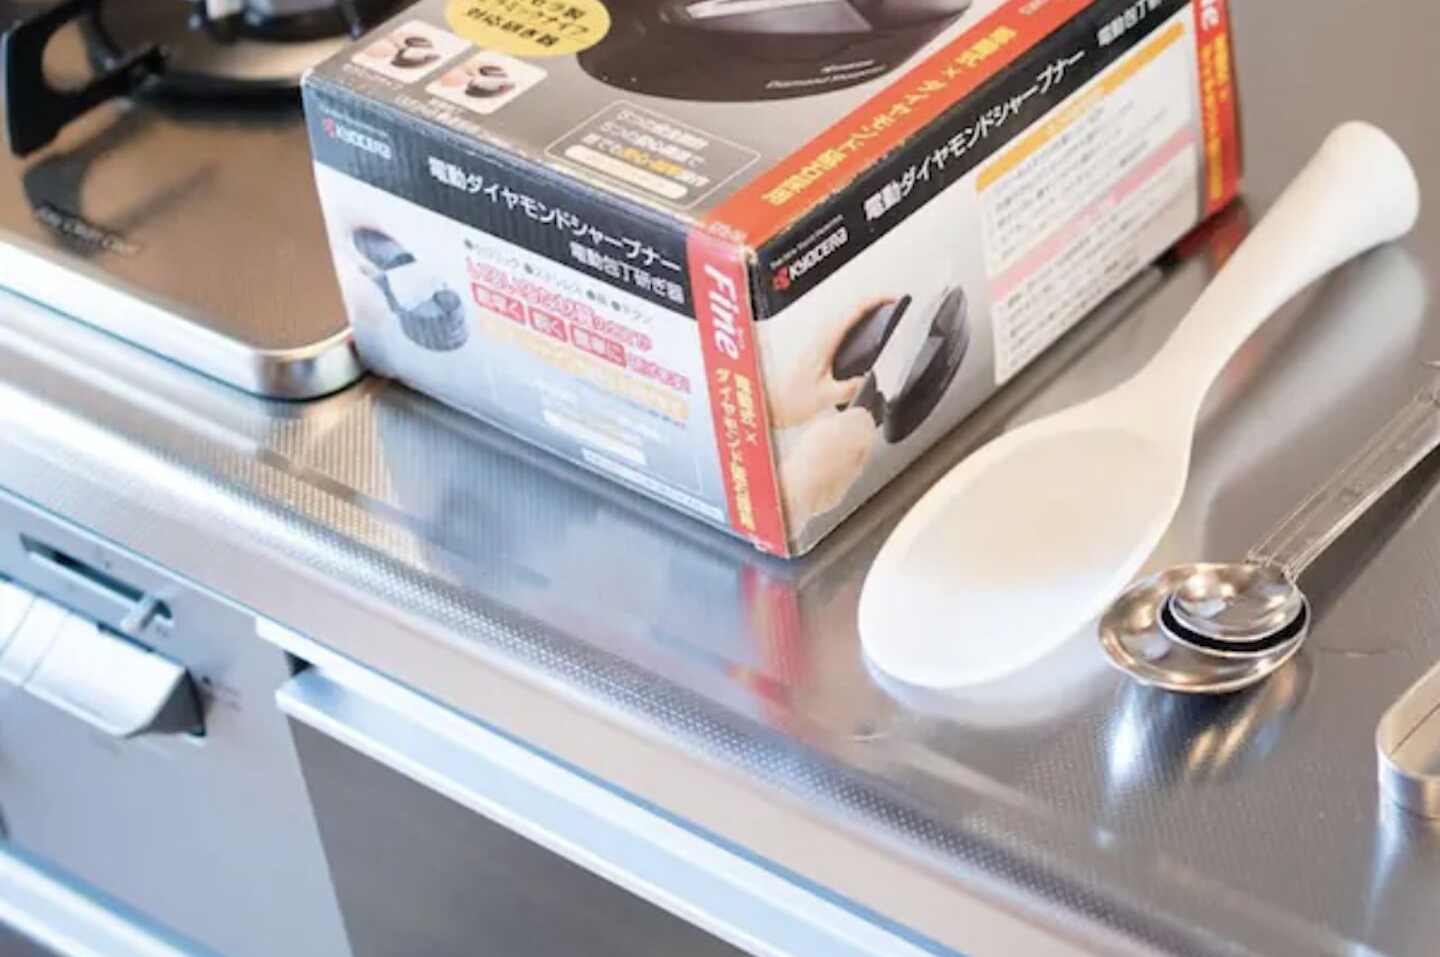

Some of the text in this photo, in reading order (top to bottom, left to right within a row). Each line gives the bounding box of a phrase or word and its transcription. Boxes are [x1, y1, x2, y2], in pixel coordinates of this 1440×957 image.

[862, 47, 1086, 222] 電動ダイヤモンドシャープナー
[427, 155, 682, 272] 電動ダイヤモンドシャープナー
[788, 226, 849, 281] KYOCERA
[569, 240, 686, 305] 電動包丁研ぎ器
[703, 263, 740, 361] Fine
